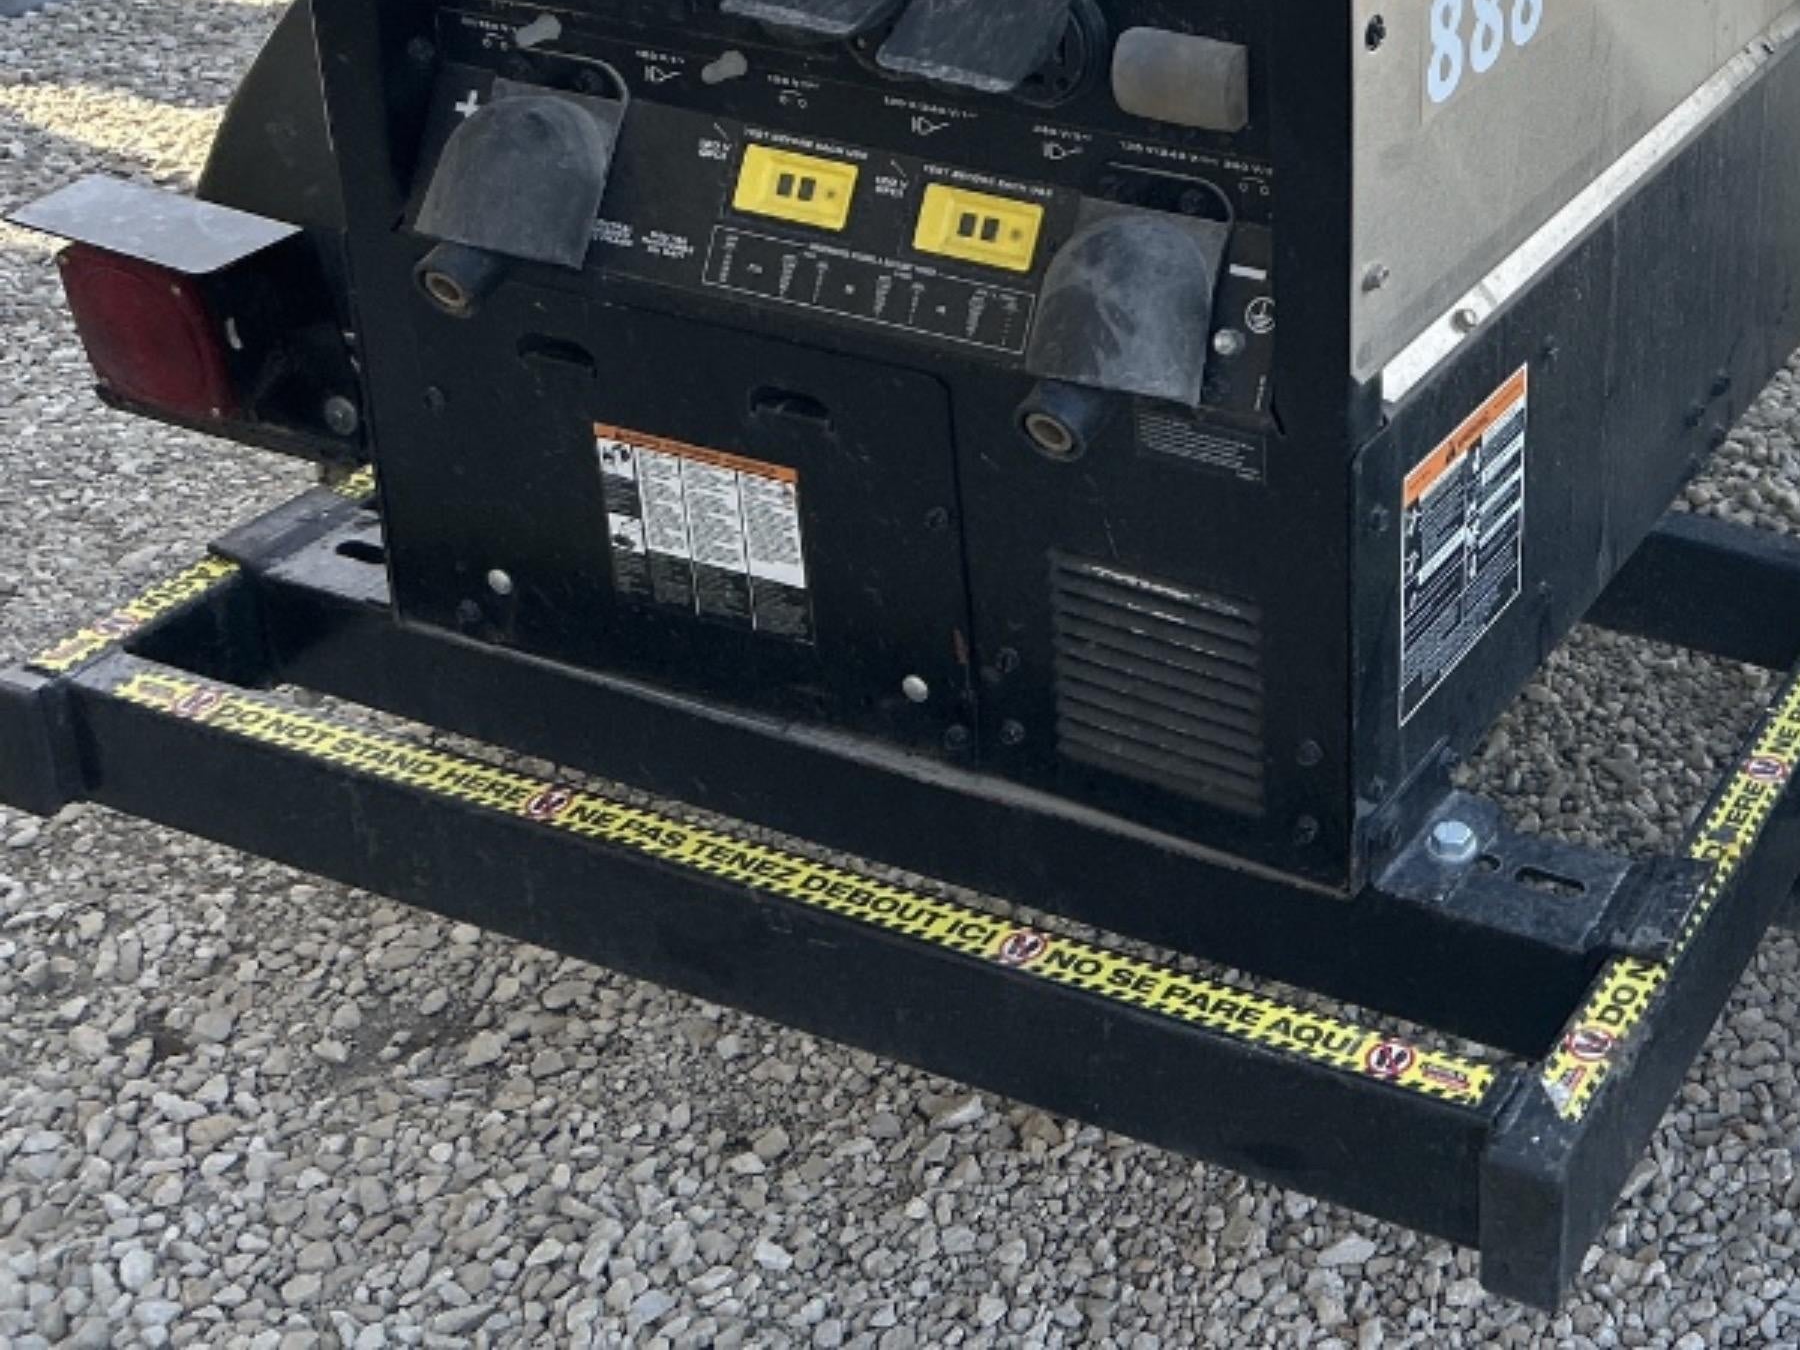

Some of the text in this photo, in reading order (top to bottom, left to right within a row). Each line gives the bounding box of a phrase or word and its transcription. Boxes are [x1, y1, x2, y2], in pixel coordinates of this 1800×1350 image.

[216, 703, 530, 802] DO NOT STAND HERE
[1770, 725, 1799, 754] NE
[567, 804, 999, 946] NE PAS TENEZ DEBOUT ICI
[1044, 949, 1099, 977] NO
[1107, 965, 1163, 992] SE
[1161, 983, 1264, 1025] PARE
[1597, 985, 1638, 1025] DO
